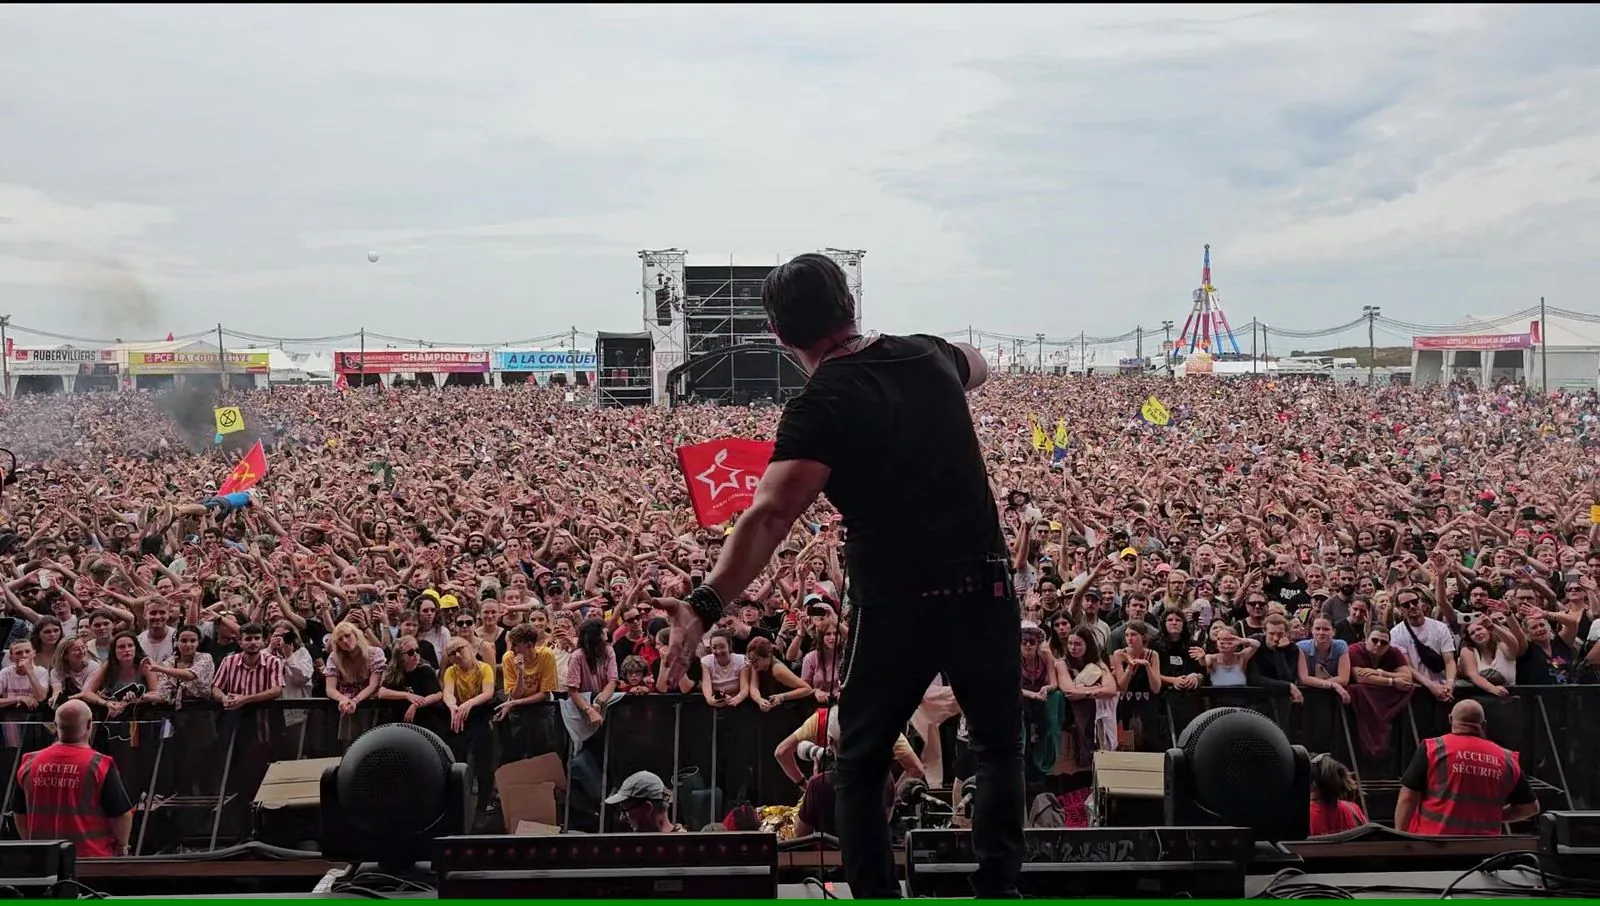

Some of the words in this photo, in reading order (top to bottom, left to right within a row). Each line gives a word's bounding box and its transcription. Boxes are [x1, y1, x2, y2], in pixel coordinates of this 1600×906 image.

[33, 350, 96, 361] AUBERVILLIERS
[154, 353, 173, 362] PCF
[177, 353, 189, 362] LA
[193, 353, 249, 362] COUREUVE
[401, 353, 466, 363] CHAMPIGNY
[521, 354, 535, 364] LA
[1455, 750, 1502, 767] ACCUEIL
[37, 762, 80, 775] ACCUEIL
[1452, 761, 1503, 780] SÉCURITÉ
[33, 775, 80, 789] SÉCURITÉ
